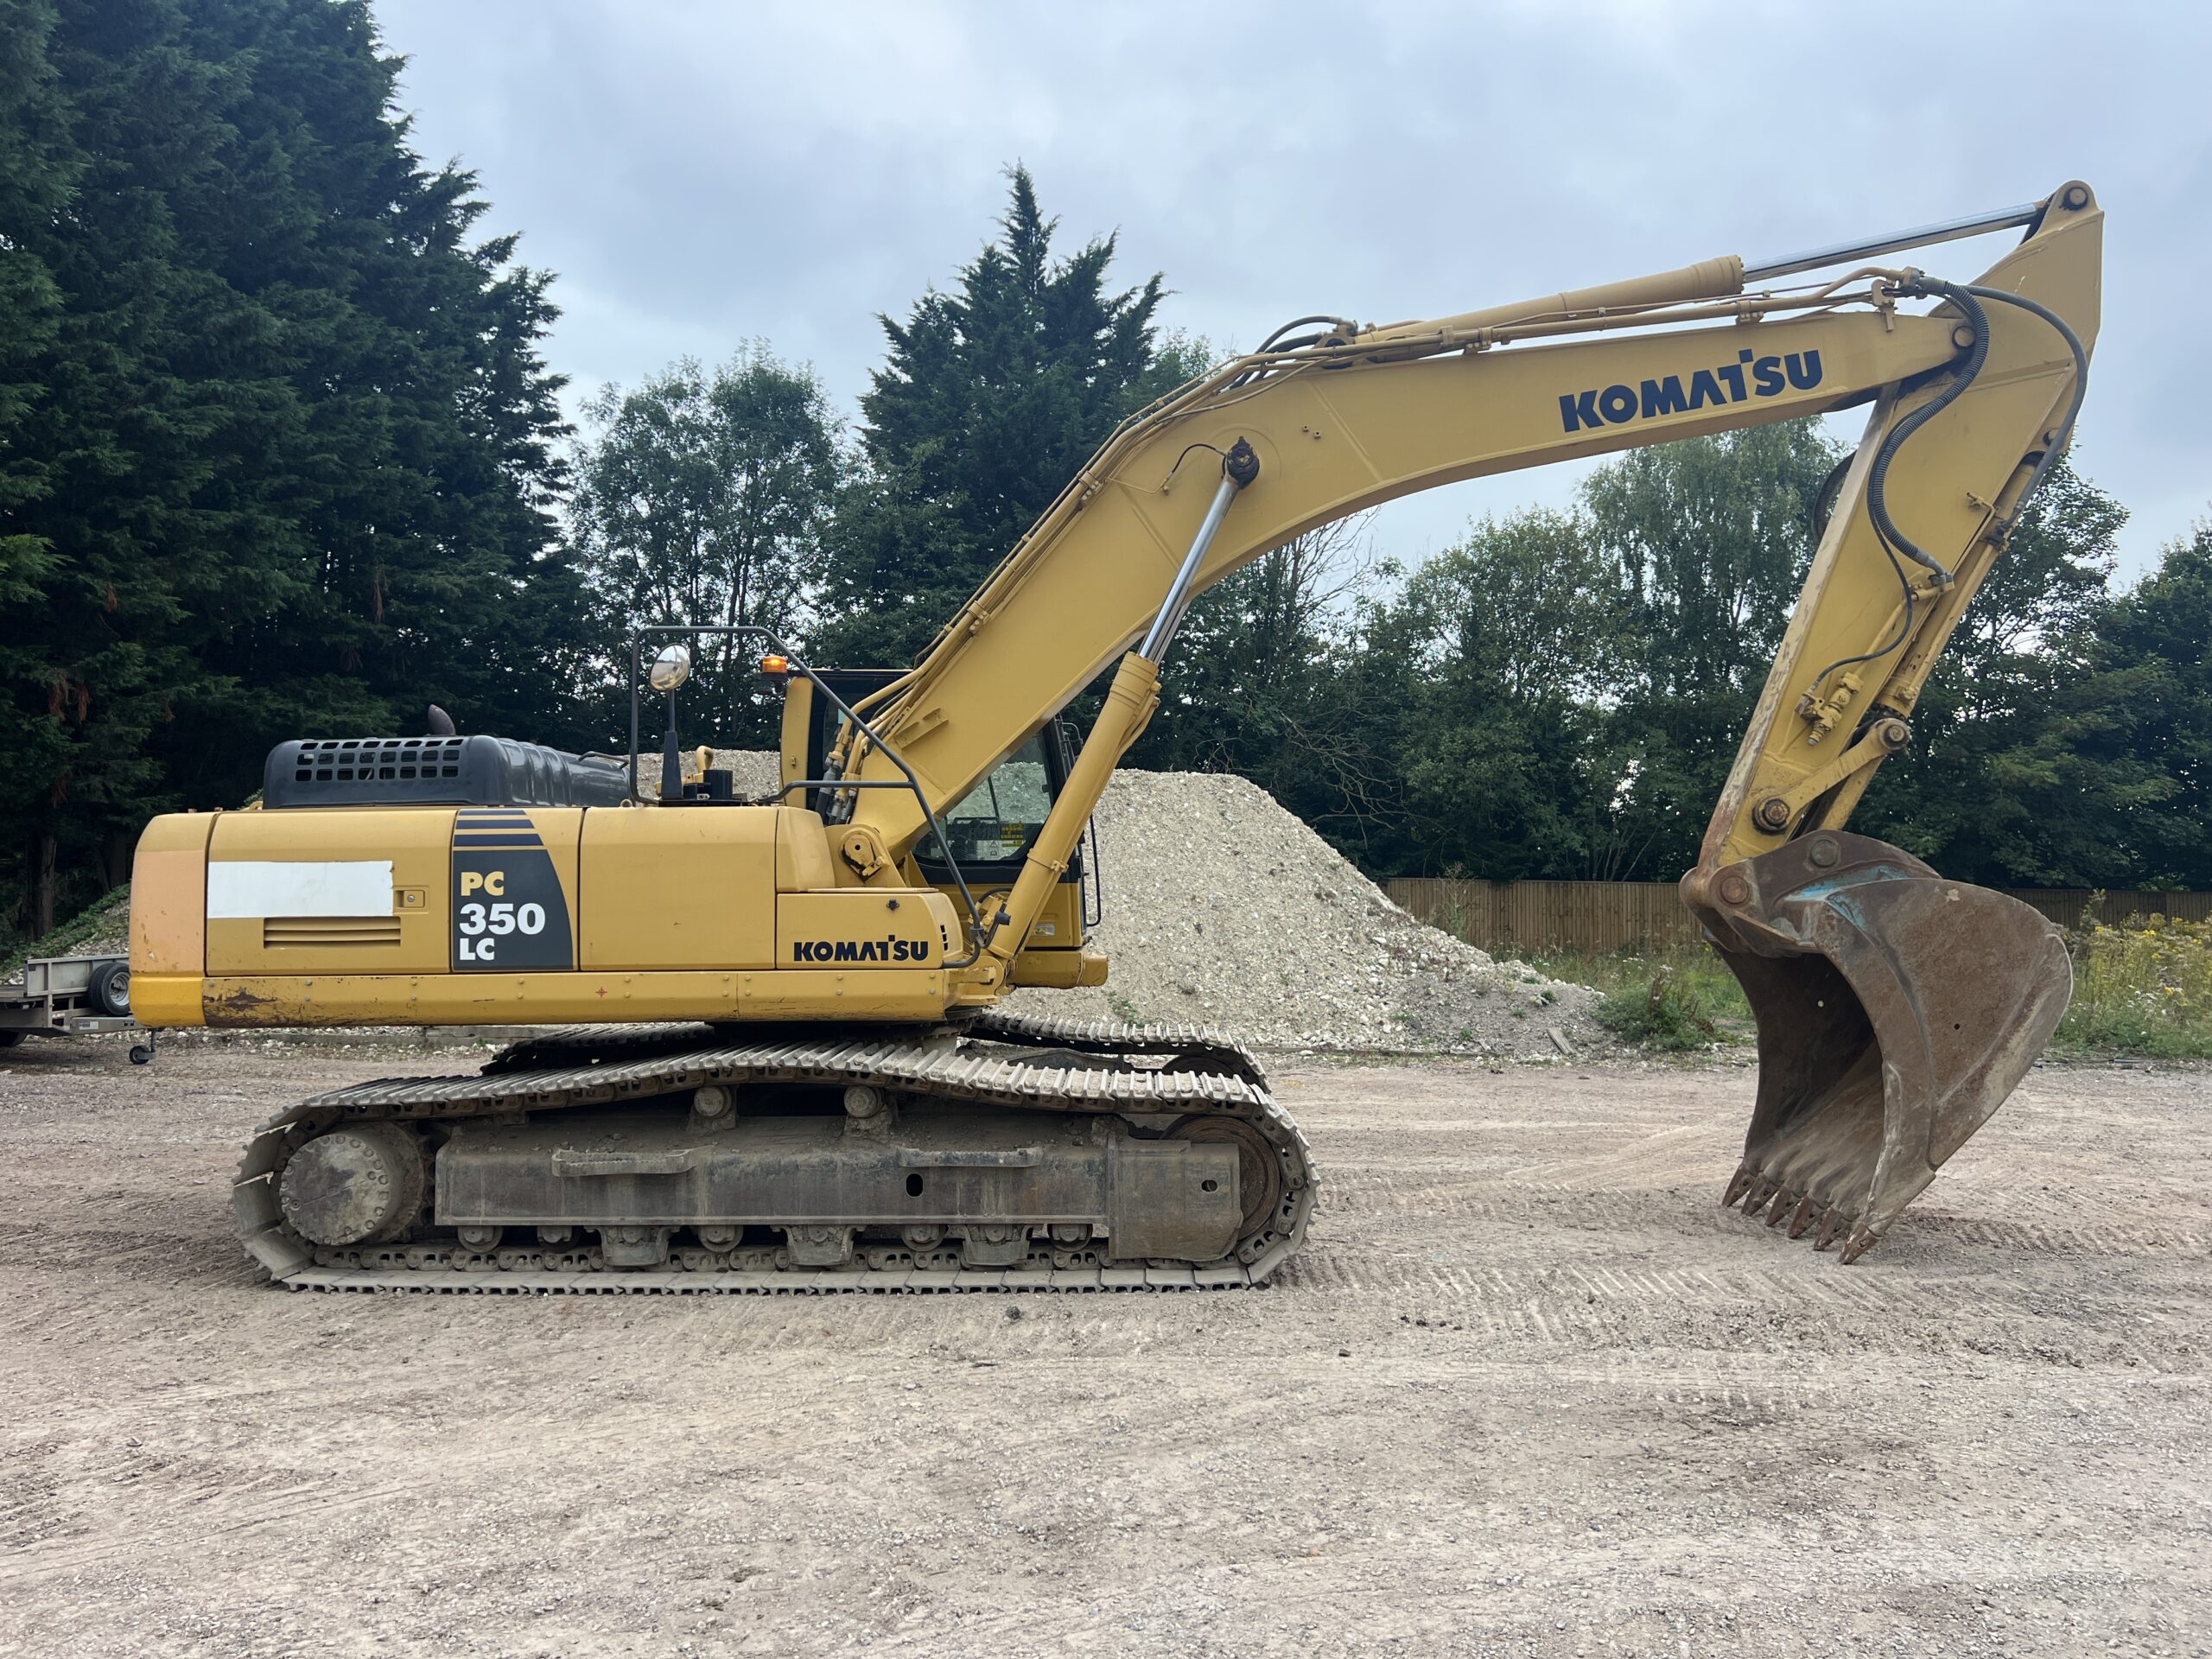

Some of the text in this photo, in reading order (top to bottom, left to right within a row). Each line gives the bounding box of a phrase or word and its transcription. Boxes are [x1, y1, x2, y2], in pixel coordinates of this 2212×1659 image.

[1559, 348, 1823, 433] KOMATSU
[461, 871, 505, 896] PC
[459, 903, 546, 935] 350
[459, 938, 495, 961] LC
[793, 934, 929, 962] KOMATSU
